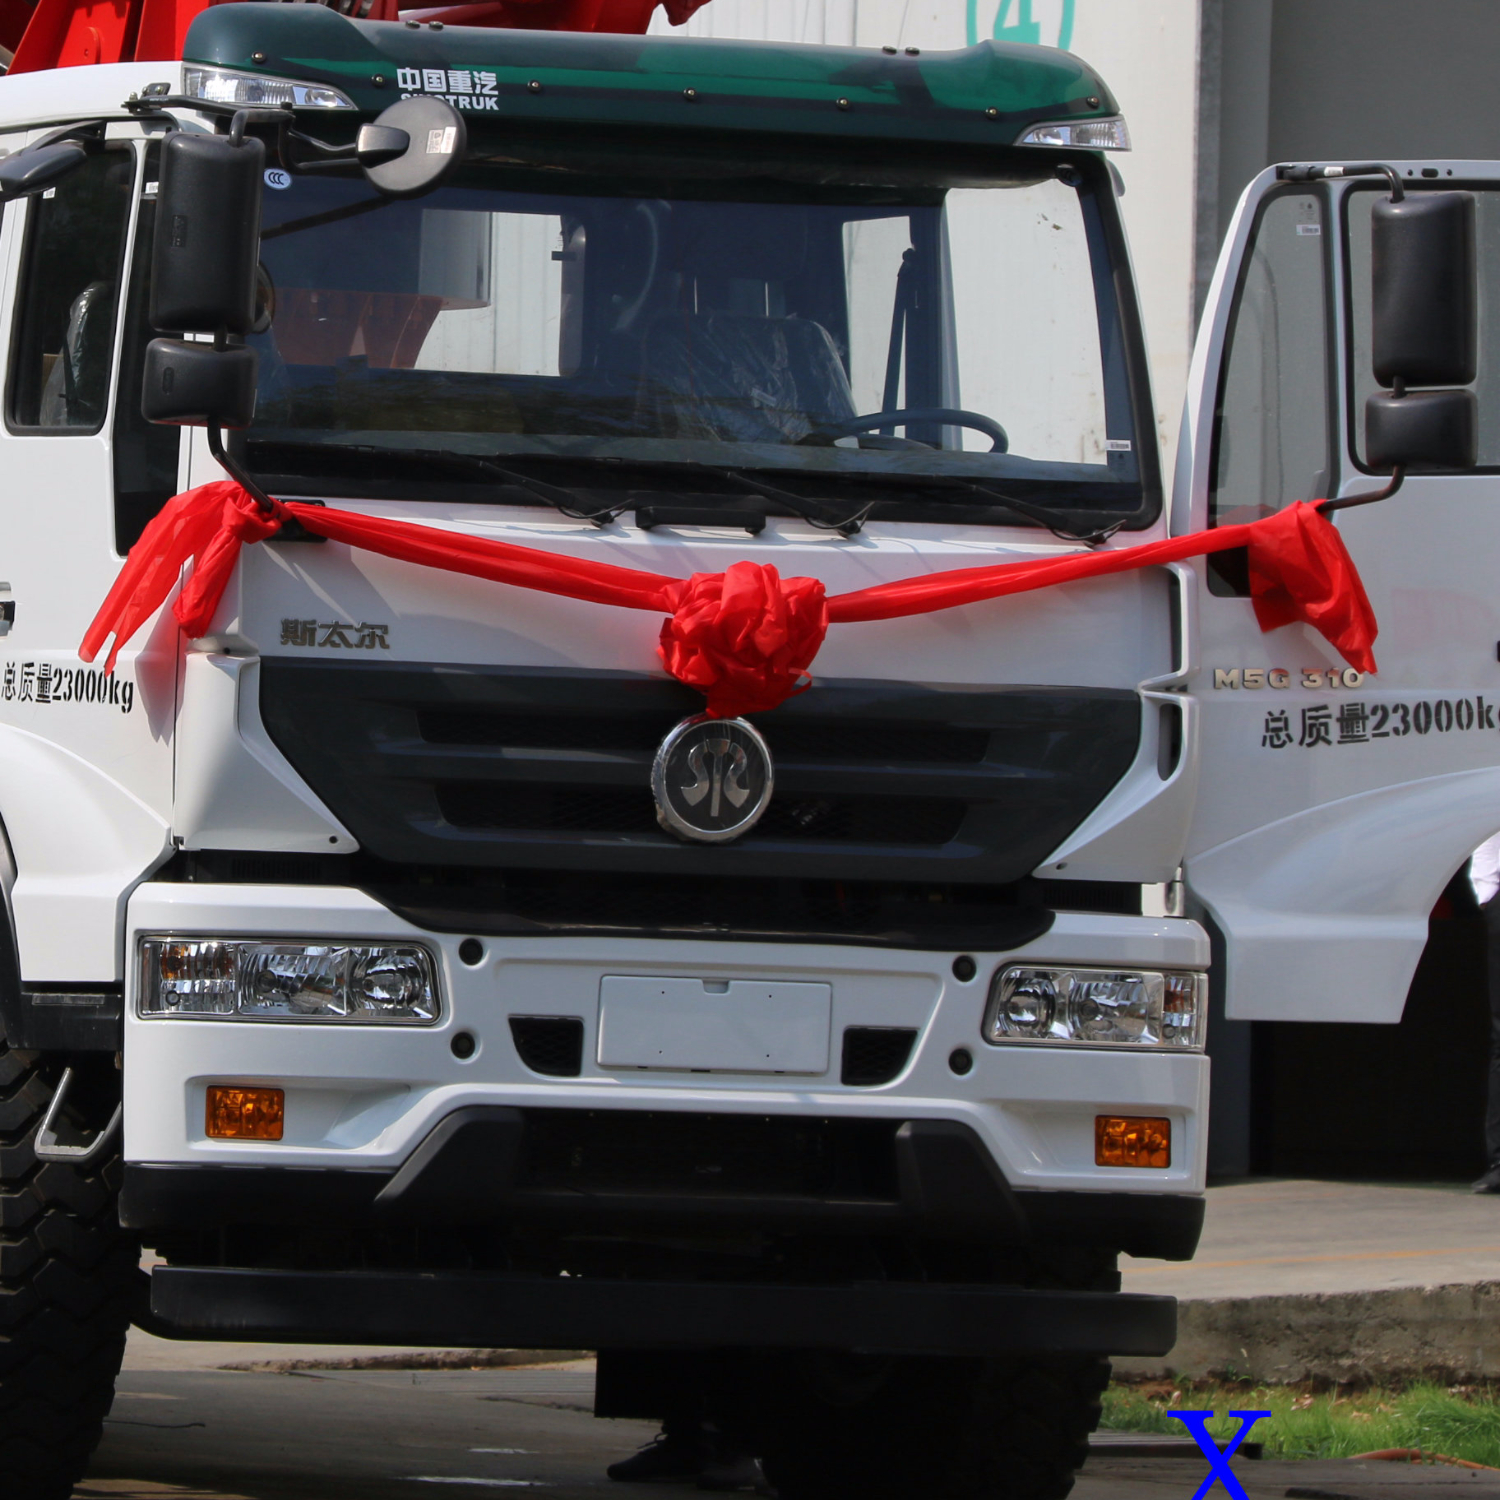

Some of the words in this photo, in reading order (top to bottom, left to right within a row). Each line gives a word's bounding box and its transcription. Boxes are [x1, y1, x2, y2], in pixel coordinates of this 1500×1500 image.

[992, 0, 1040, 45] 4
[396, 67, 499, 95] 中国重汽
[400, 93, 499, 110] TRUK
[280, 618, 390, 649] 斯太尔
[1213, 668, 1290, 689] M5G
[1301, 667, 1364, 688] 310
[1261, 695, 1500, 749] 总质量23000k
